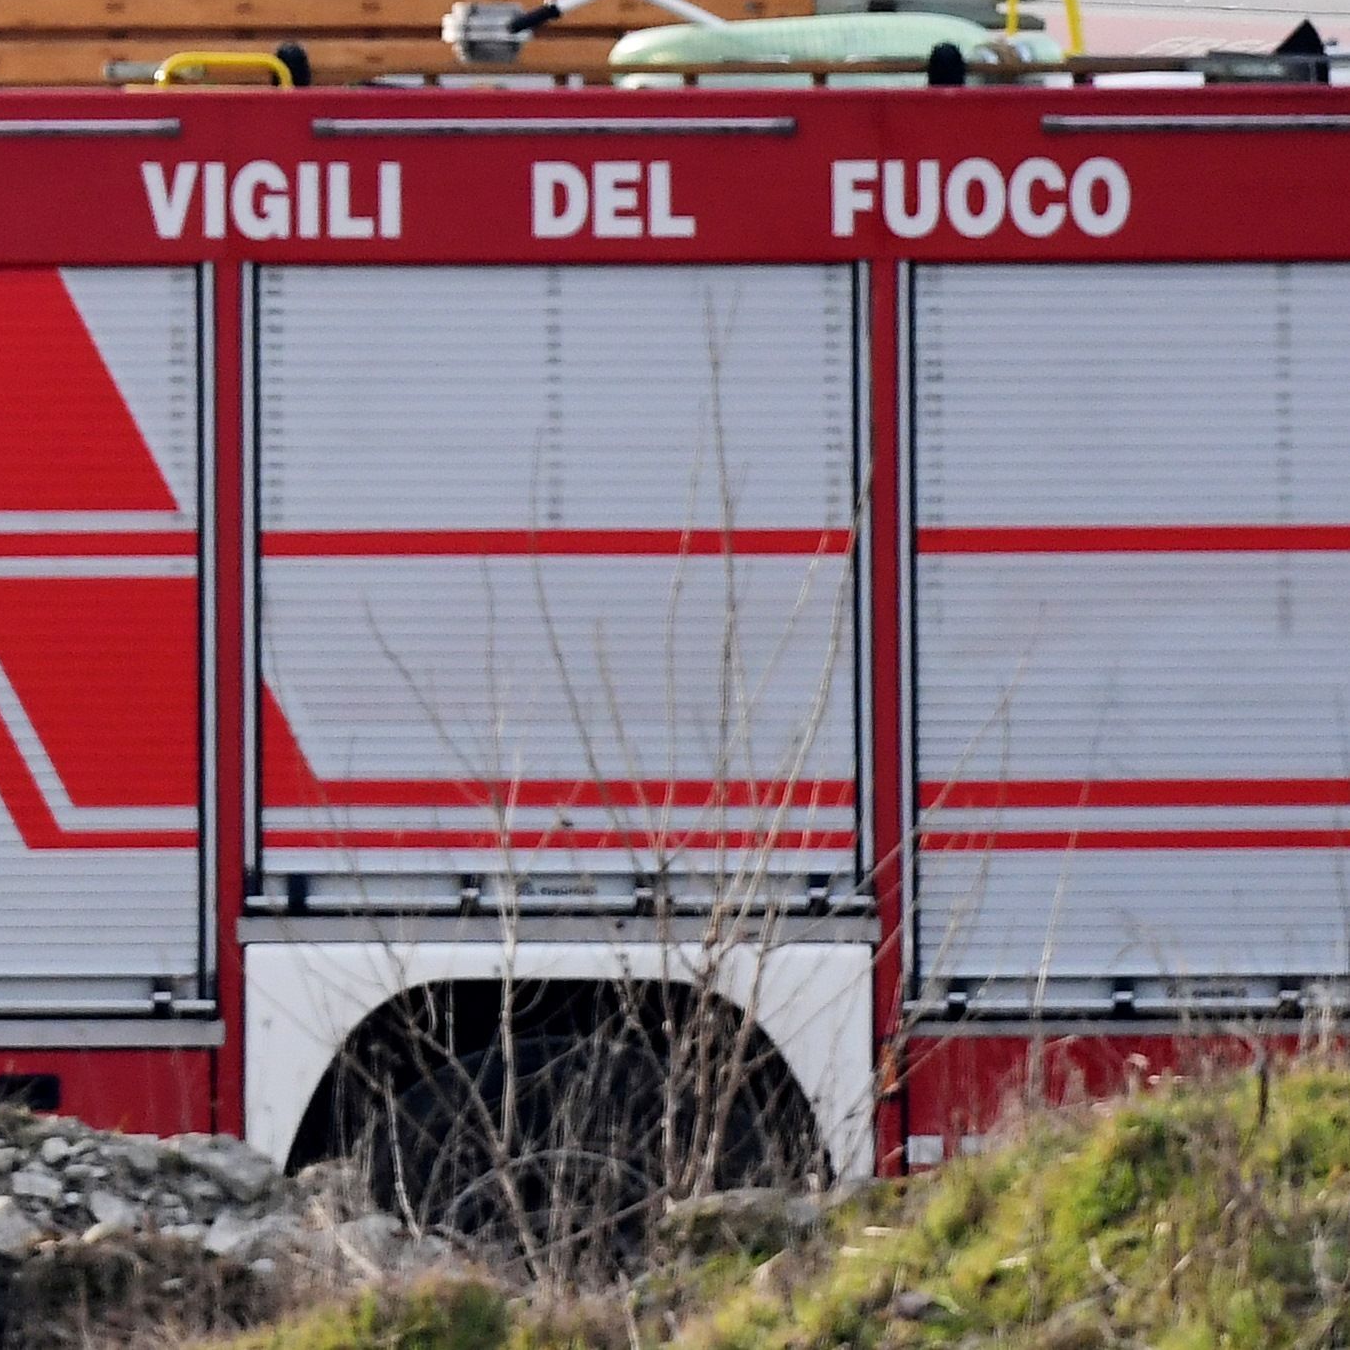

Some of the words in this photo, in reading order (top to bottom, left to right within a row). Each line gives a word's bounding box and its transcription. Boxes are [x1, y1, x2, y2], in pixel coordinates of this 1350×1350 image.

[142, 161, 402, 239] VIGILI
[532, 161, 696, 239] DEL
[831, 157, 1132, 239] FUOCO
